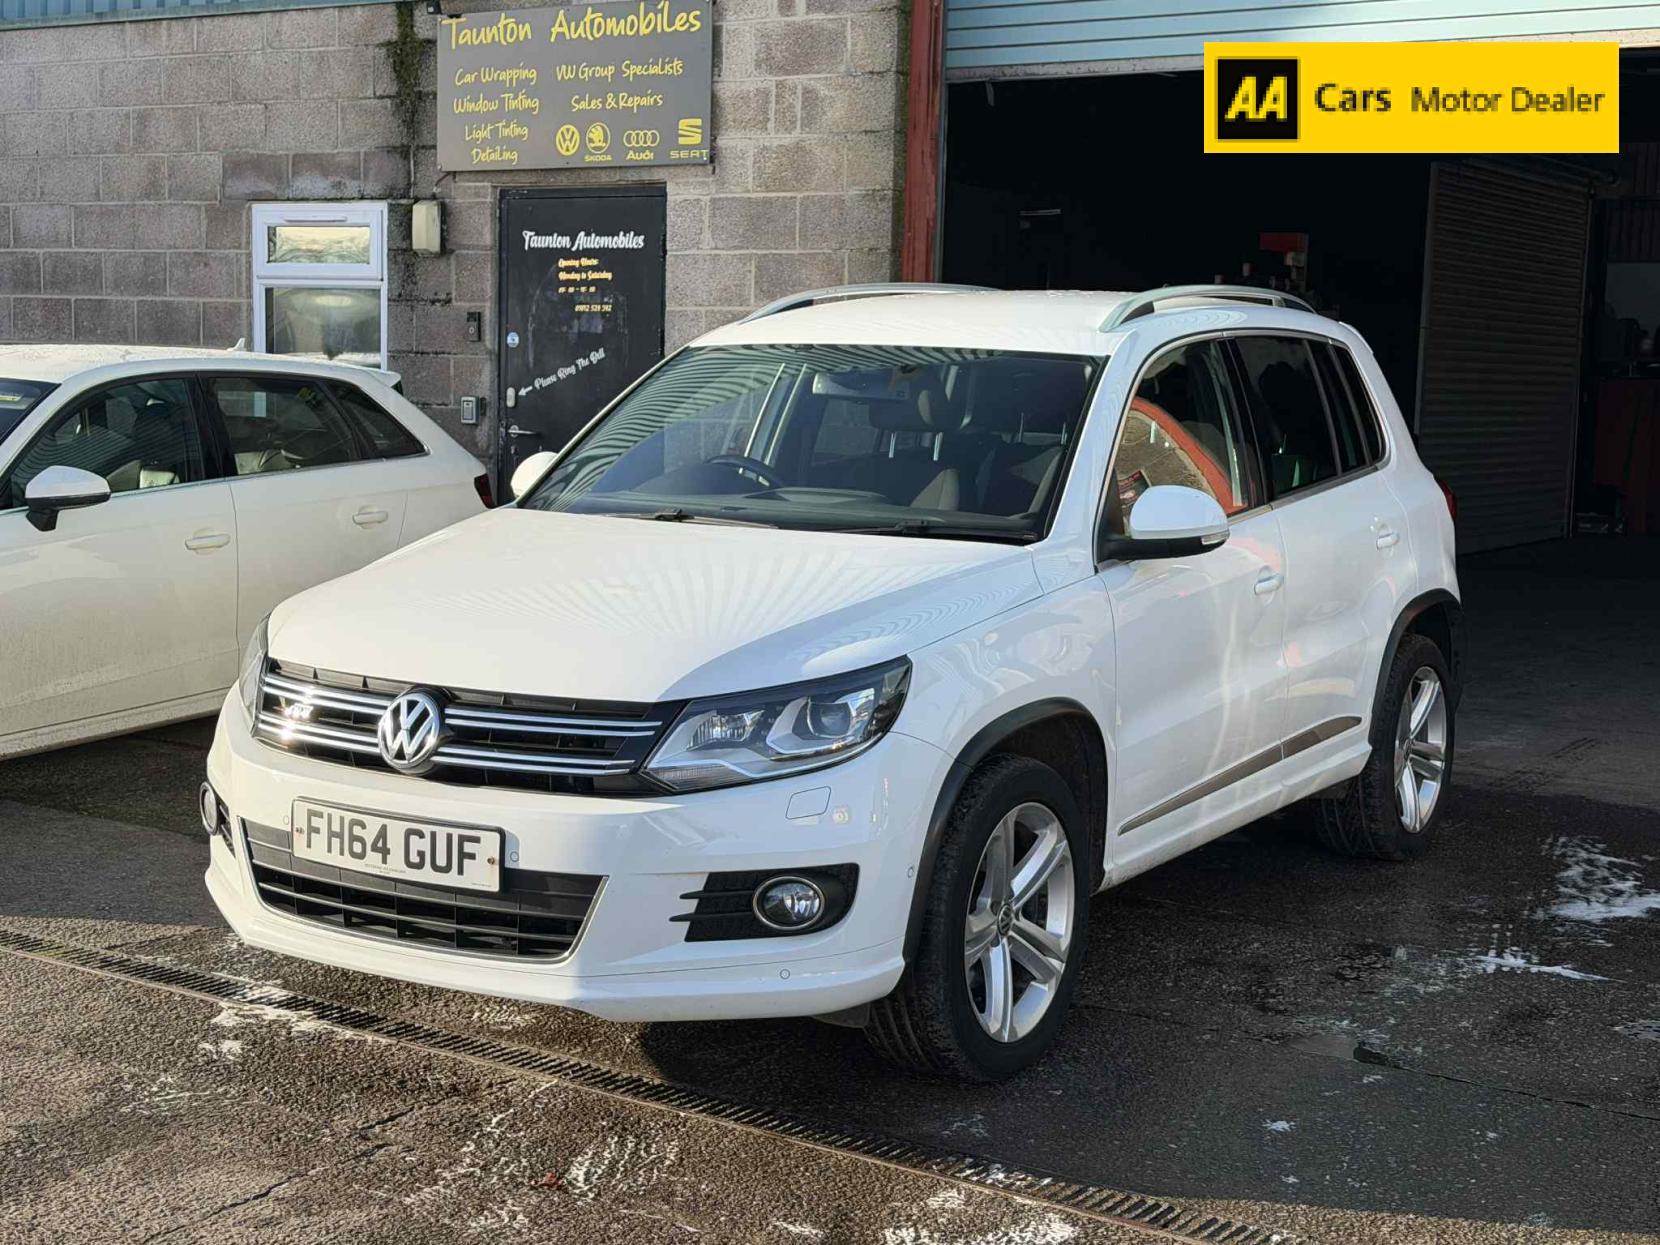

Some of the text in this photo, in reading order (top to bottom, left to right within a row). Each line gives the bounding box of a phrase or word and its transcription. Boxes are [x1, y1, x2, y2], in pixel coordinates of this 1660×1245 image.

[441, 0, 701, 49] Taunton Automobiles
[455, 62, 537, 87] Car Wrapping
[556, 57, 684, 82] VW Group Specialists
[453, 89, 540, 114] Window Tinting
[571, 89, 663, 113] Sales & Repairs
[464, 119, 529, 144] Light Tinting
[471, 145, 518, 165] Detailing
[626, 150, 654, 160] Audi
[669, 150, 709, 159] SEAT
[522, 230, 645, 251] Taunton Automobiles
[534, 347, 606, 390] Please Ring The Bell
[306, 808, 481, 876] FH64 GUF
